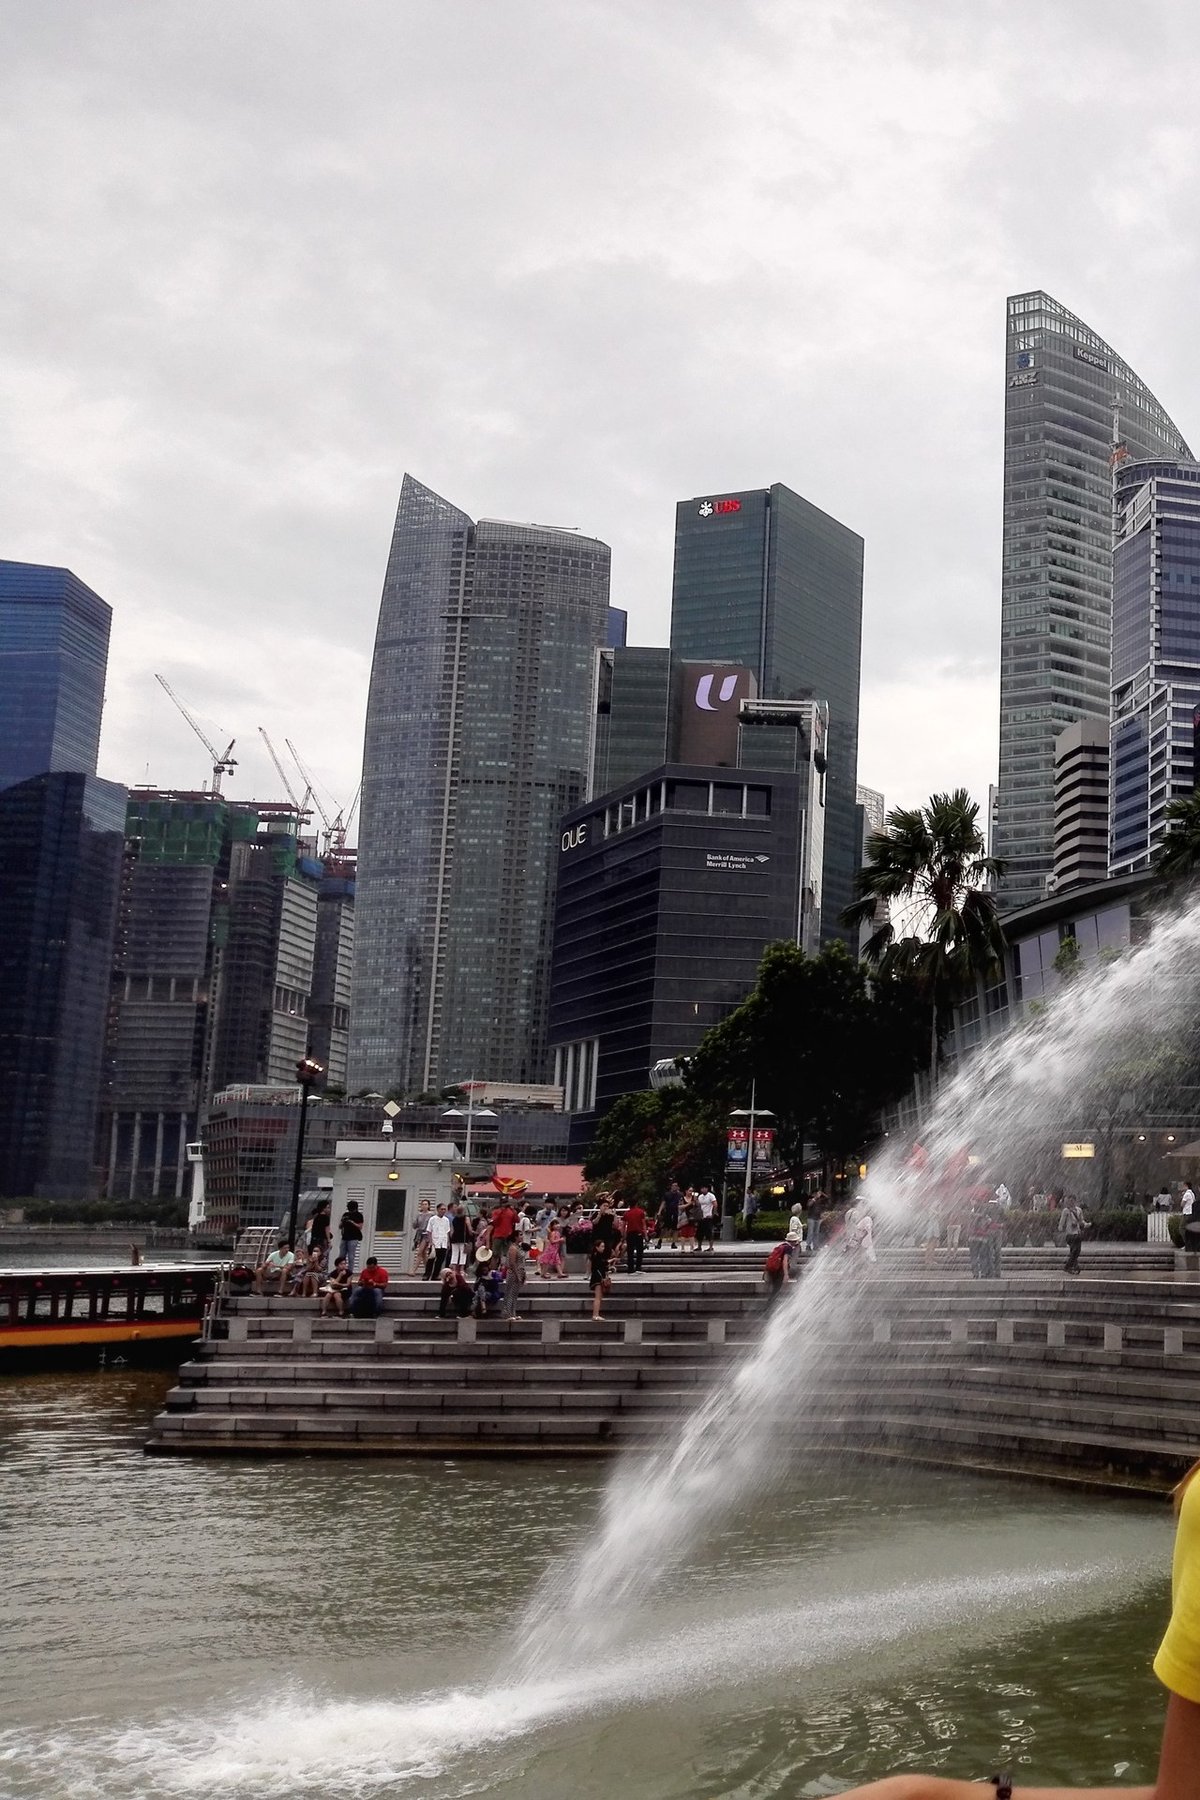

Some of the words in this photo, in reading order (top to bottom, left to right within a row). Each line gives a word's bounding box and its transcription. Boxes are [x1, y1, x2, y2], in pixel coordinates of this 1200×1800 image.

[1077, 347, 1107, 368] Keppel
[714, 500, 741, 513] UBS
[562, 823, 587, 852] OUE
[730, 855, 755, 863] America
